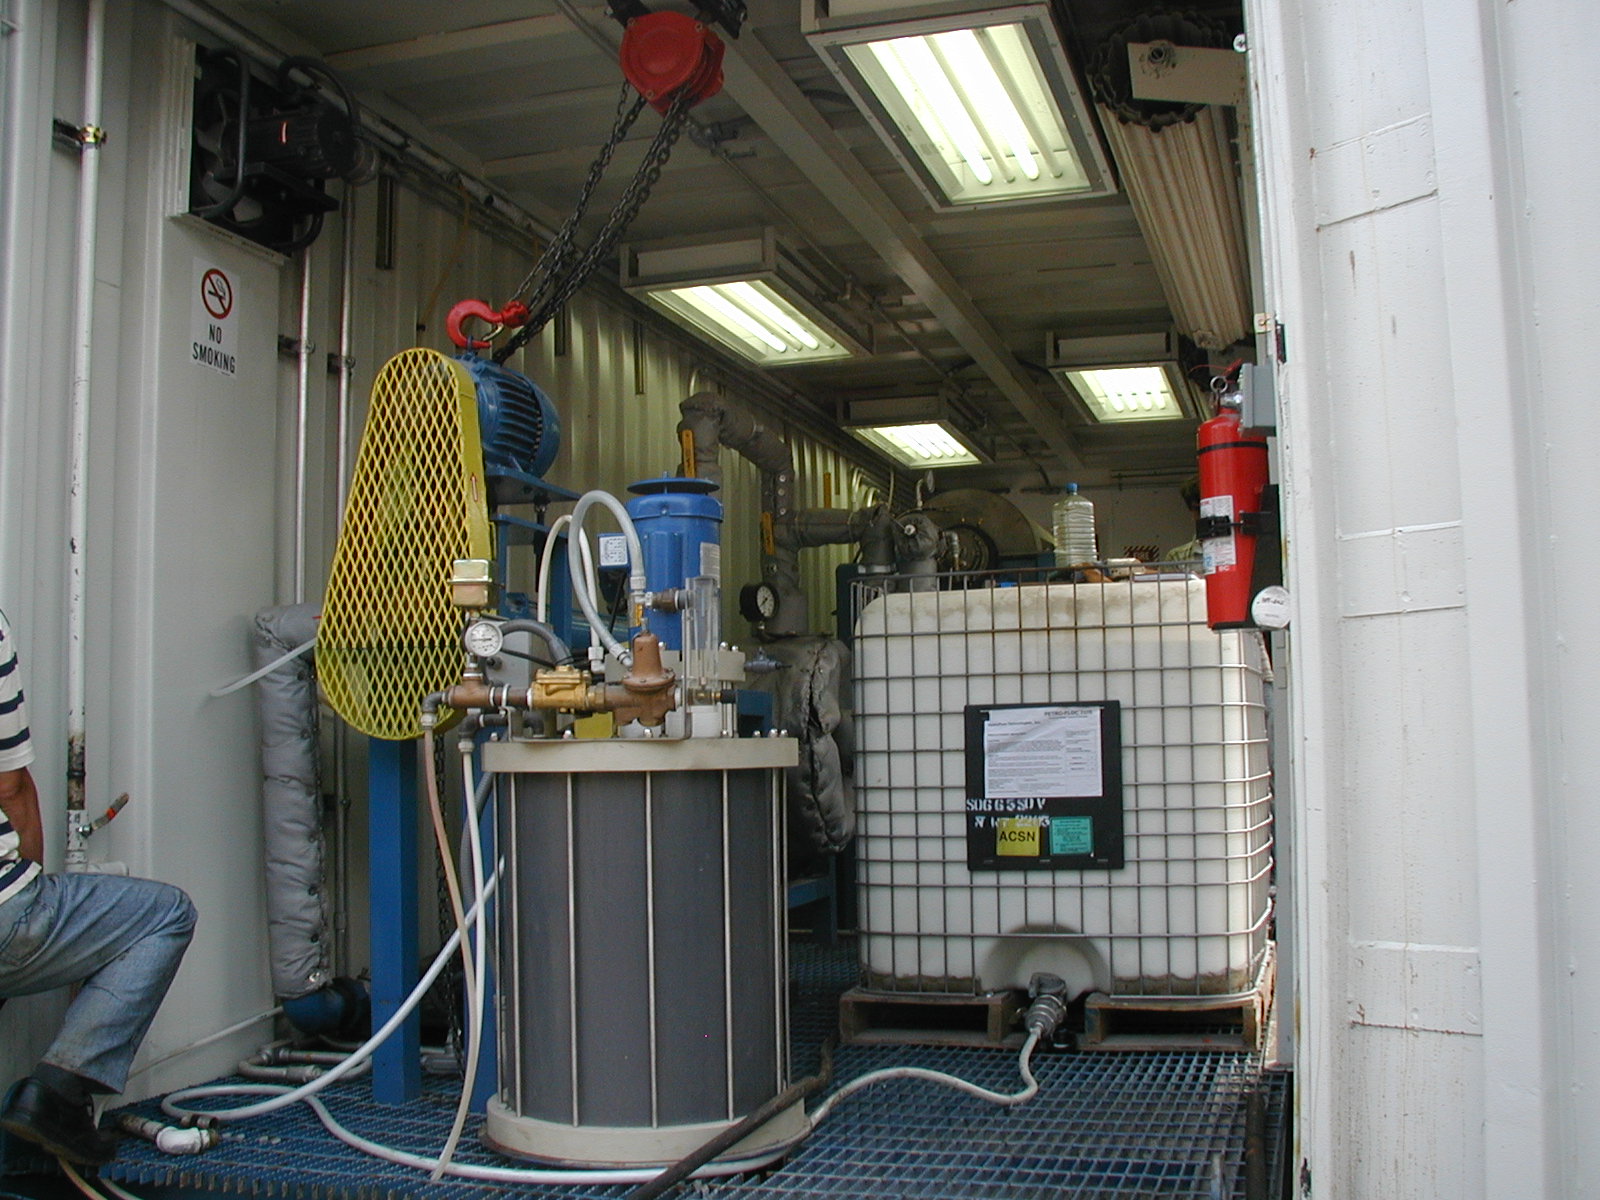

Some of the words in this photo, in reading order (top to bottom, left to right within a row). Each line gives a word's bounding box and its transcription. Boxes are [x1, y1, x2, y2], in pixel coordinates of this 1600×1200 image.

[209, 324, 222, 344] NO
[192, 342, 235, 374] SMOKING
[999, 831, 1035, 842] ACSN
